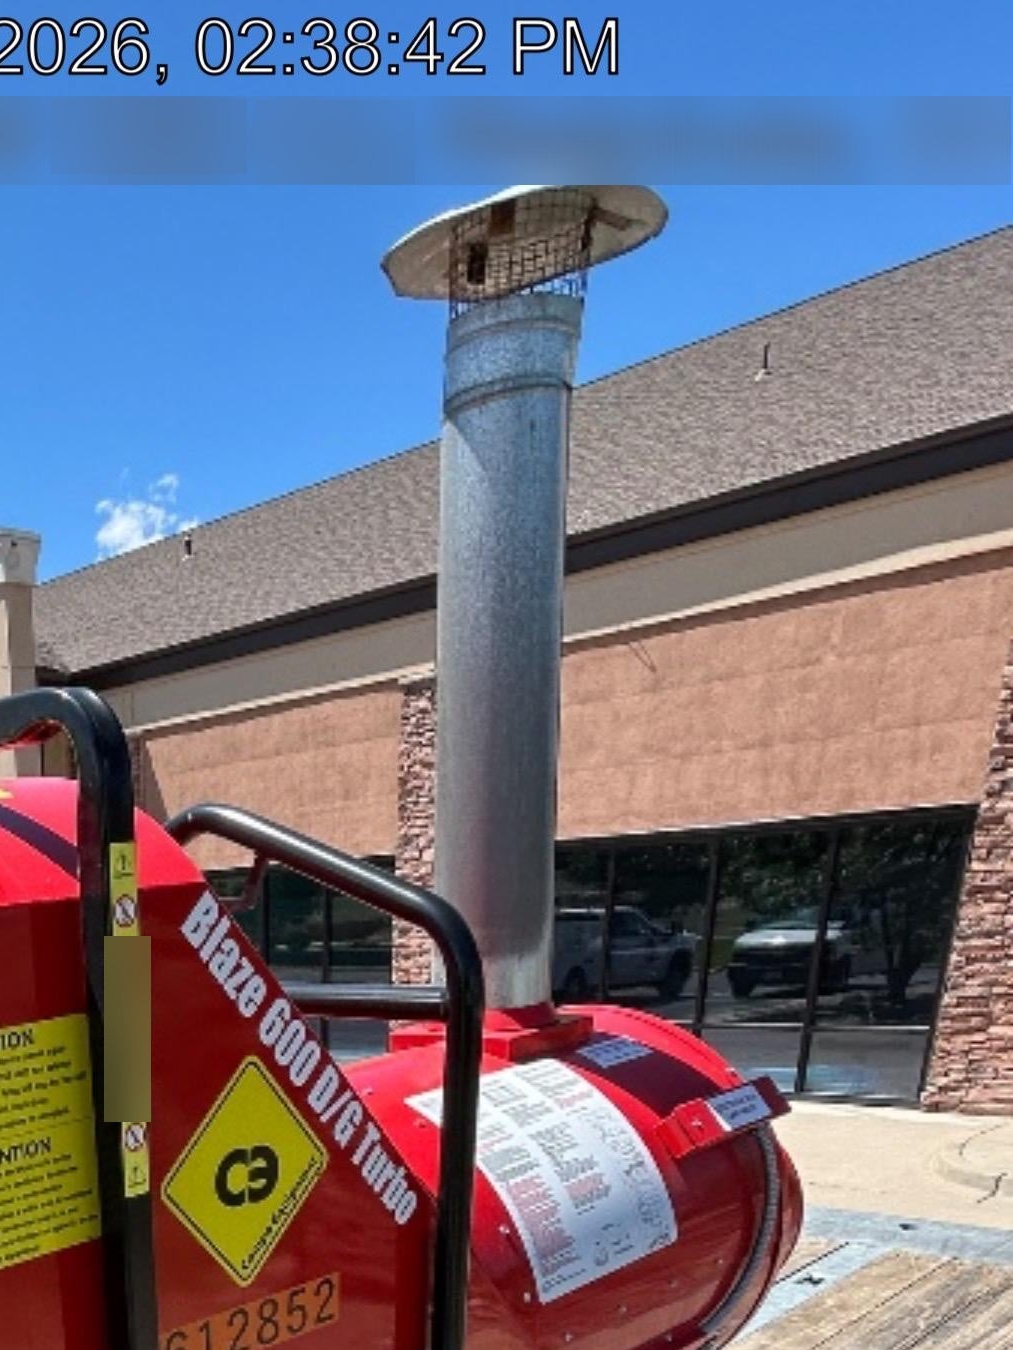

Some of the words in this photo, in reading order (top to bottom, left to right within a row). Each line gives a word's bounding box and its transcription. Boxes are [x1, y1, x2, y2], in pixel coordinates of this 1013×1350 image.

[181, 890, 267, 1018] Blaze
[259, 998, 321, 1087] 600
[308, 1064, 363, 1149] D/G
[351, 1121, 417, 1225] Turbo
